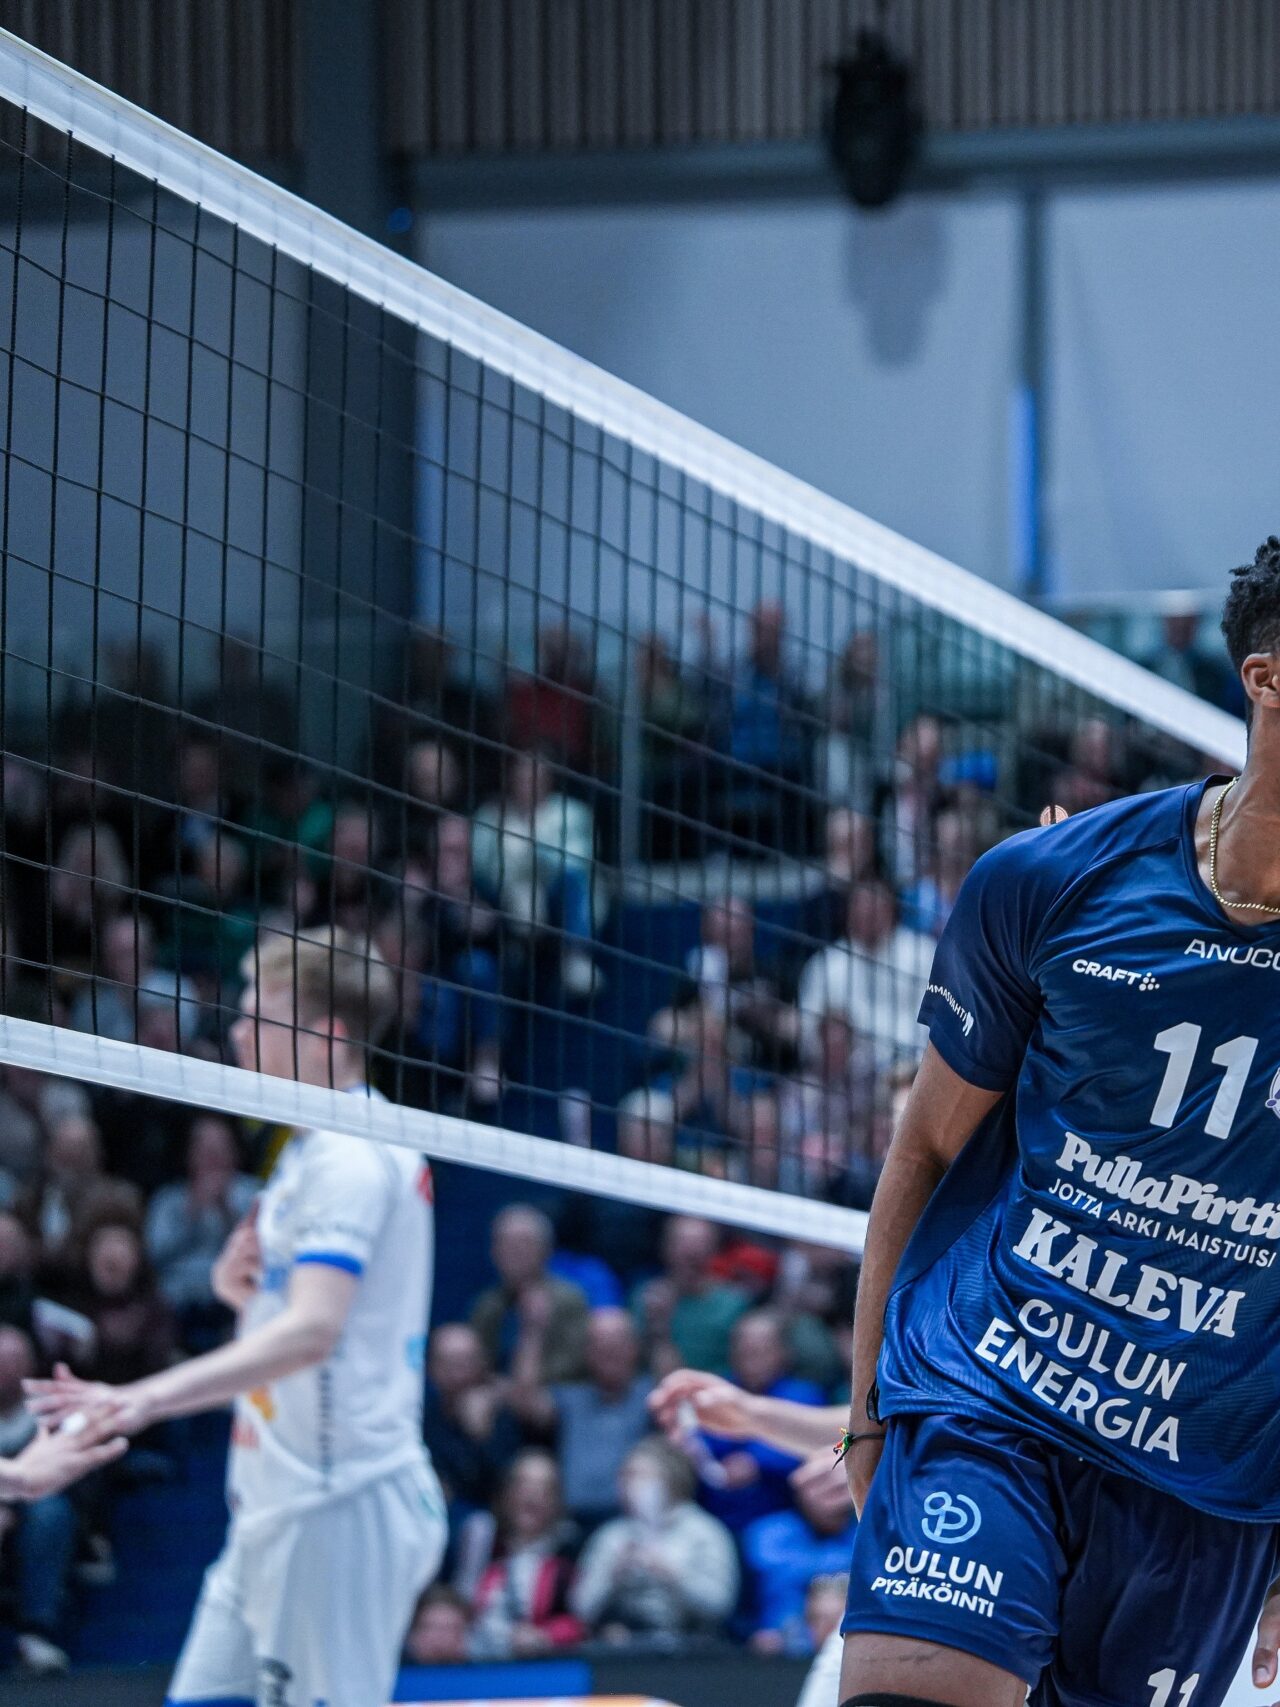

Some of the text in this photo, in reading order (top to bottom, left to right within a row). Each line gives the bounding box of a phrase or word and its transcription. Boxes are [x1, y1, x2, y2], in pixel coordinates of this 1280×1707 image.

[926, 984, 967, 1022] MMASVAHTI
[1072, 958, 1142, 986] CRAFT
[1149, 1021, 1259, 1140] 11
[1048, 1178, 1277, 1268] JOTTA ARKI MAISTUISI
[1012, 1207, 1246, 1338] KALEVA
[974, 1316, 1181, 1463] ENERGIA
[870, 1576, 995, 1618] PYSÄKÖINTI
[884, 1545, 1004, 1597] OULUN
